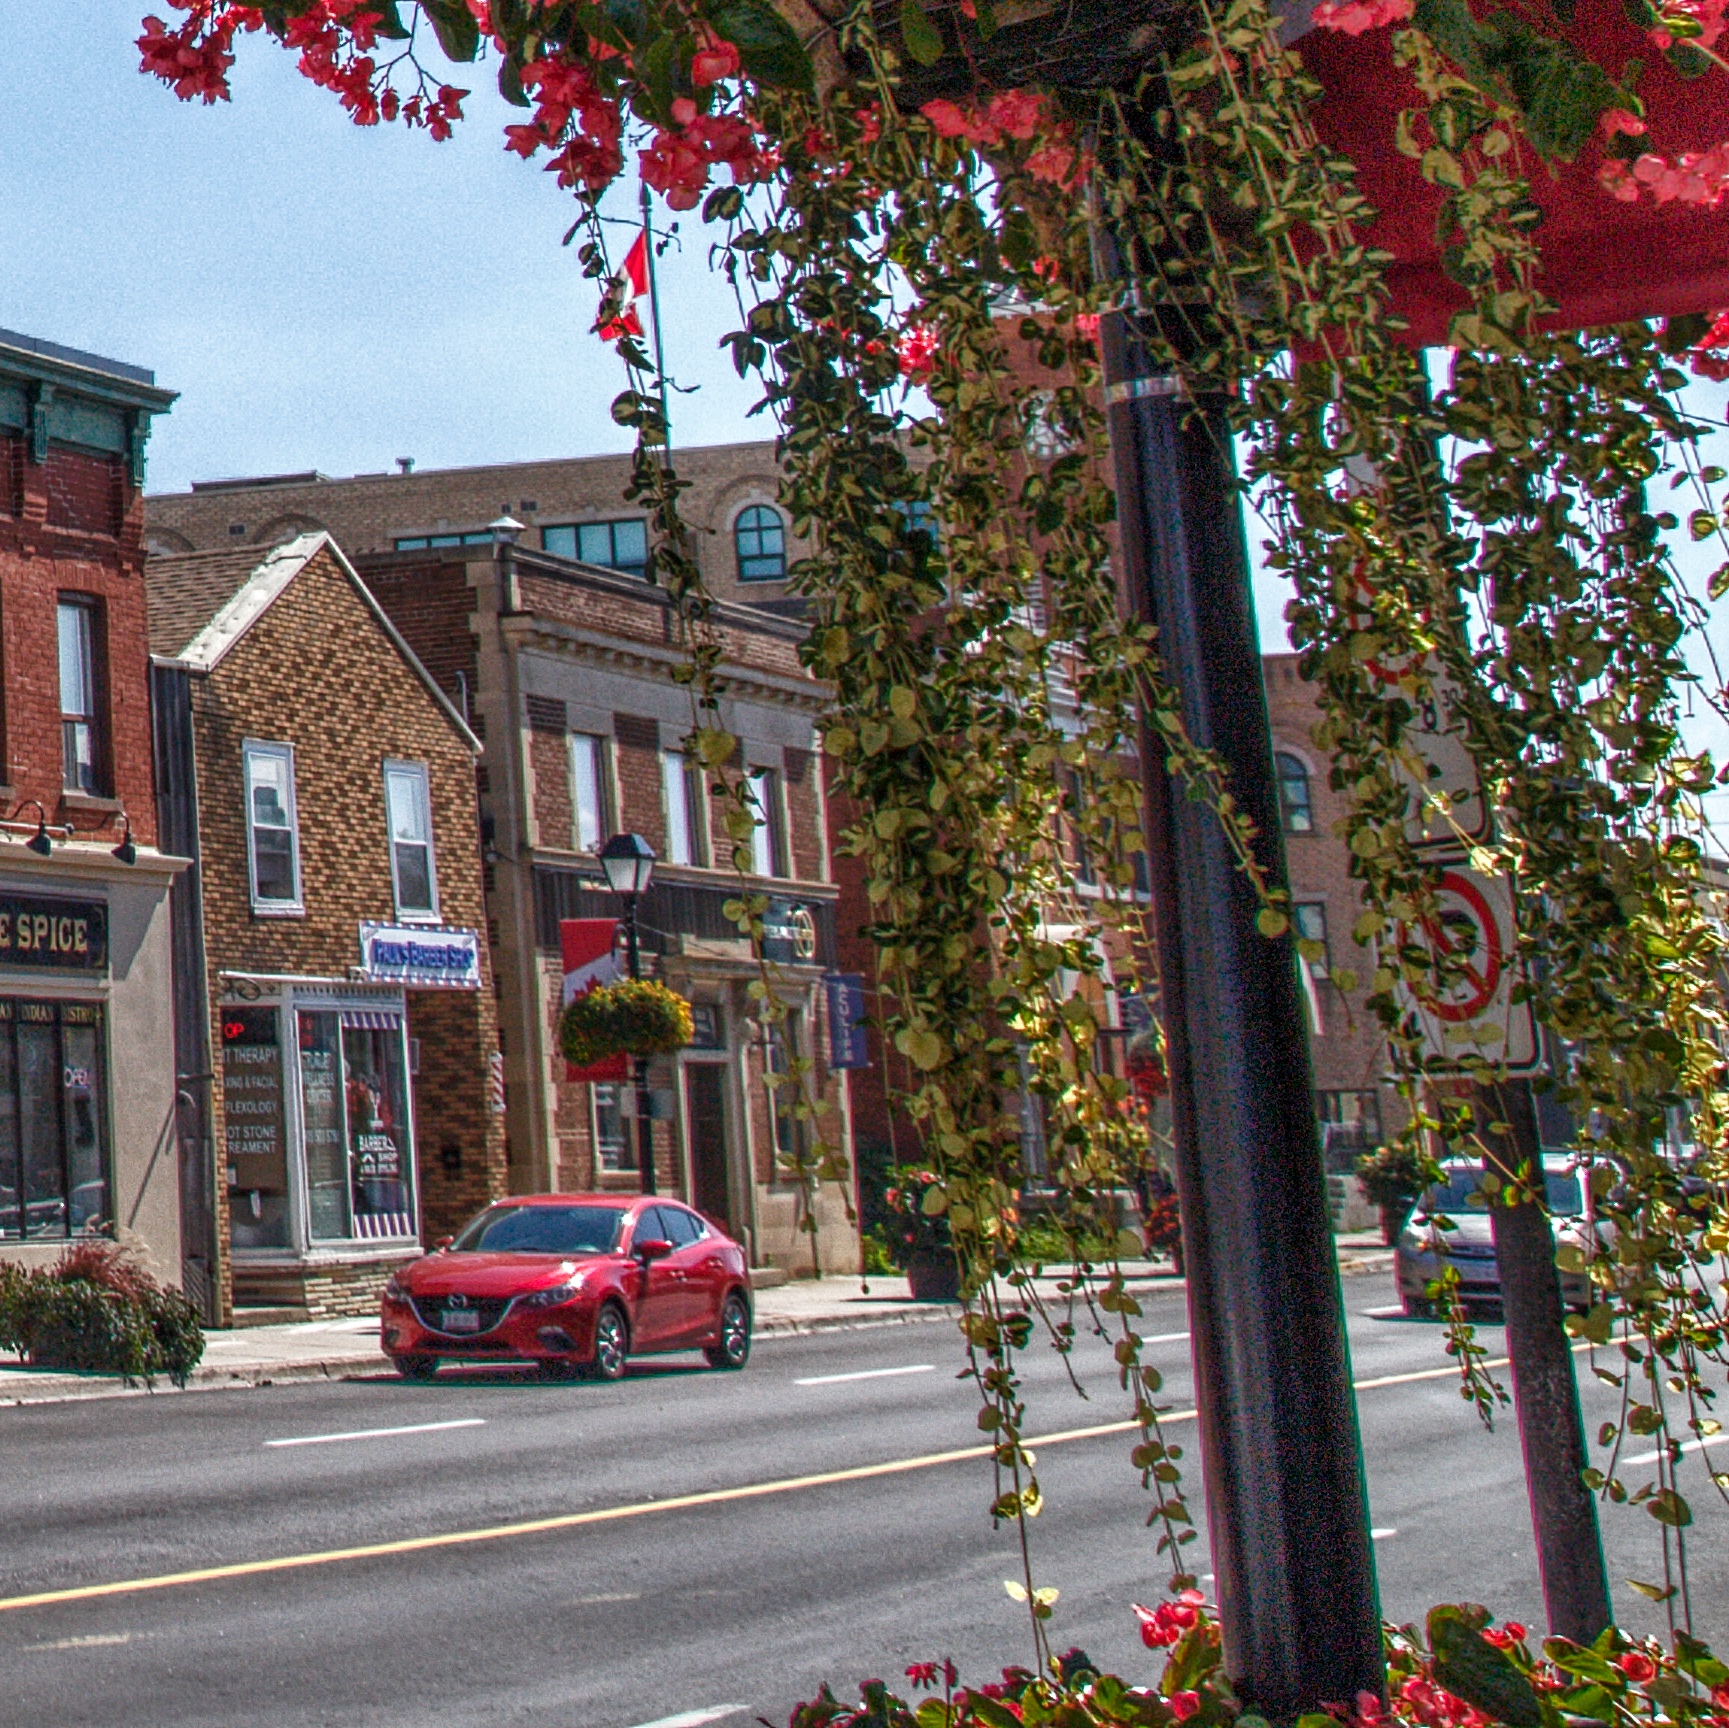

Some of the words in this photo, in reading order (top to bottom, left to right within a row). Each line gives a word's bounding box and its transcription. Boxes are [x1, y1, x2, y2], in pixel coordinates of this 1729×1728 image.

[16, 913, 88, 954] SPICE
[233, 1048, 278, 1064] THERAPY
[225, 1100, 278, 1115] FLEXOLOGY
[227, 1126, 241, 1140] OT
[243, 1125, 277, 1140] STONE
[228, 1140, 277, 1155] REAMENT
